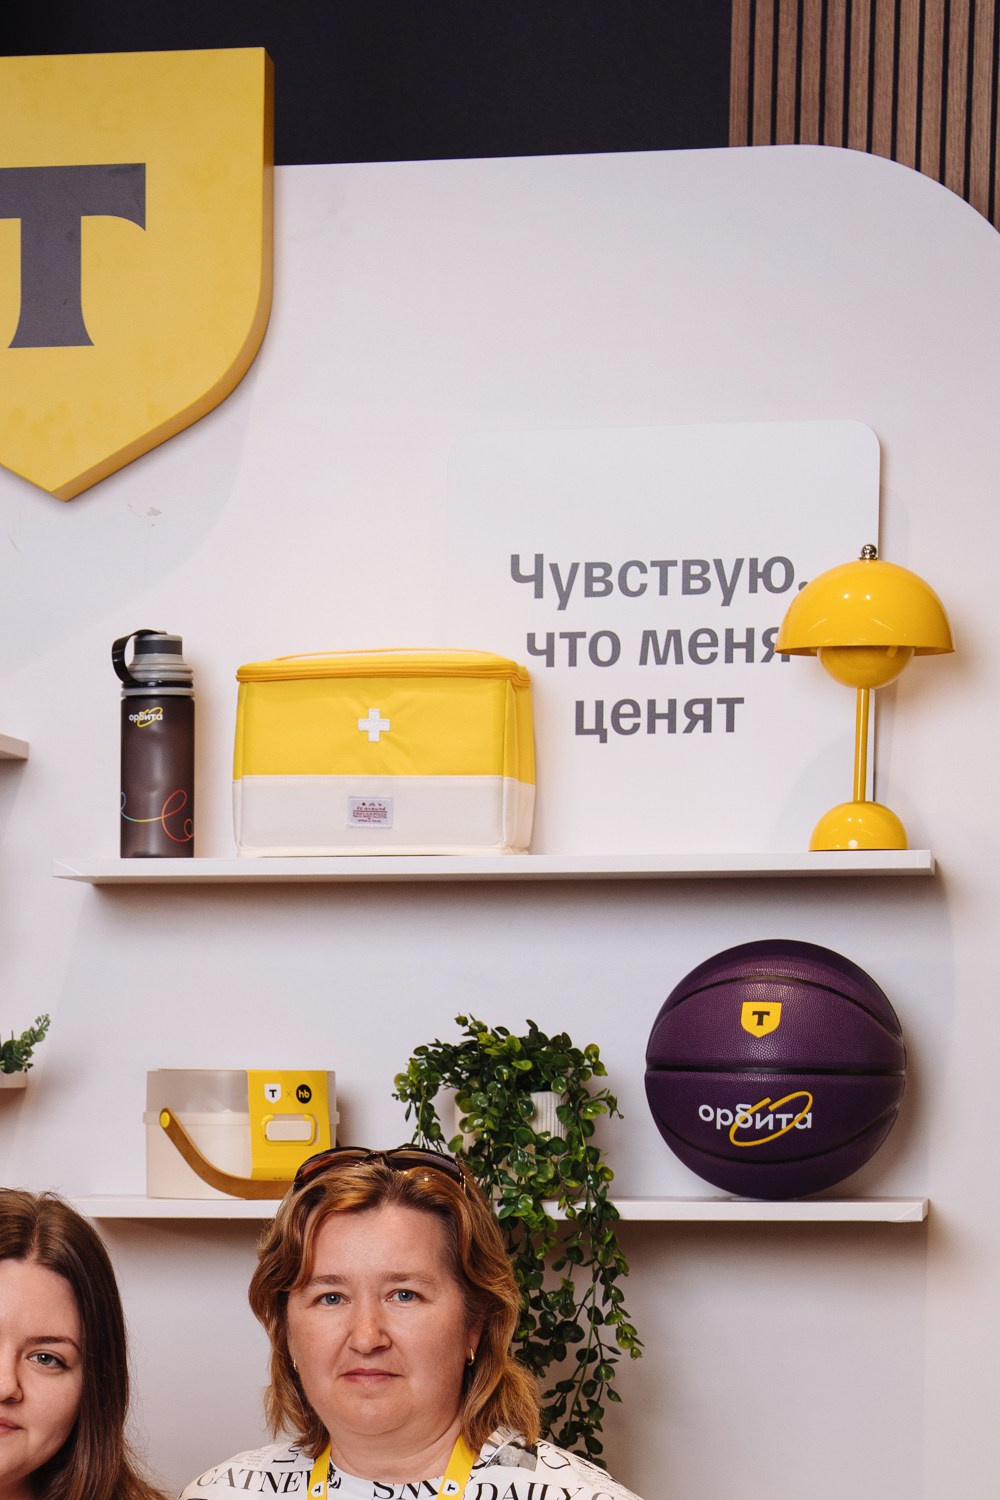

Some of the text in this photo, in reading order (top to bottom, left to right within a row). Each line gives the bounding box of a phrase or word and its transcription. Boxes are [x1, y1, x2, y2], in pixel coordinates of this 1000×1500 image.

[527, 630, 621, 668] что
[128, 711, 163, 723] орбита
[575, 697, 745, 744] ценят
[298, 1089, 310, 1098] hb
[699, 1103, 813, 1130] орбита
